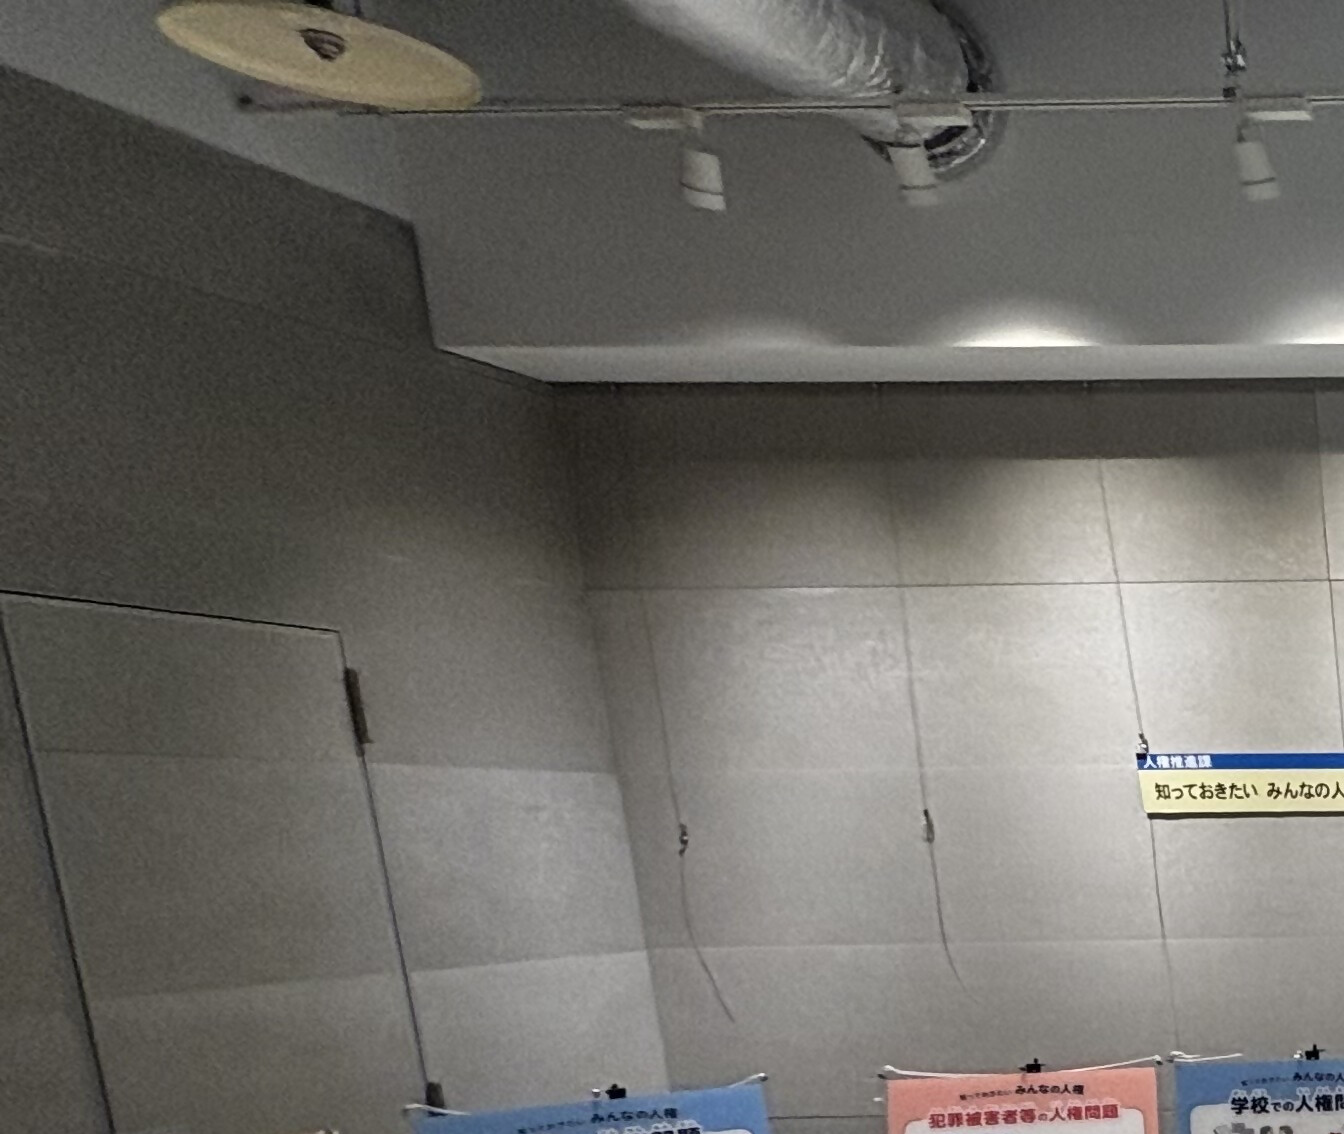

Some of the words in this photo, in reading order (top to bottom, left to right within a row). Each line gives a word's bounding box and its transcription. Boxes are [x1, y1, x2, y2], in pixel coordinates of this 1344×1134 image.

[1155, 782, 1258, 801] 知っておきたい
[1015, 1084, 1085, 1096] みんなの人権
[590, 1107, 679, 1124] みんなの人権
[928, 1104, 1120, 1128] 犯罪被害者等の人権問題
